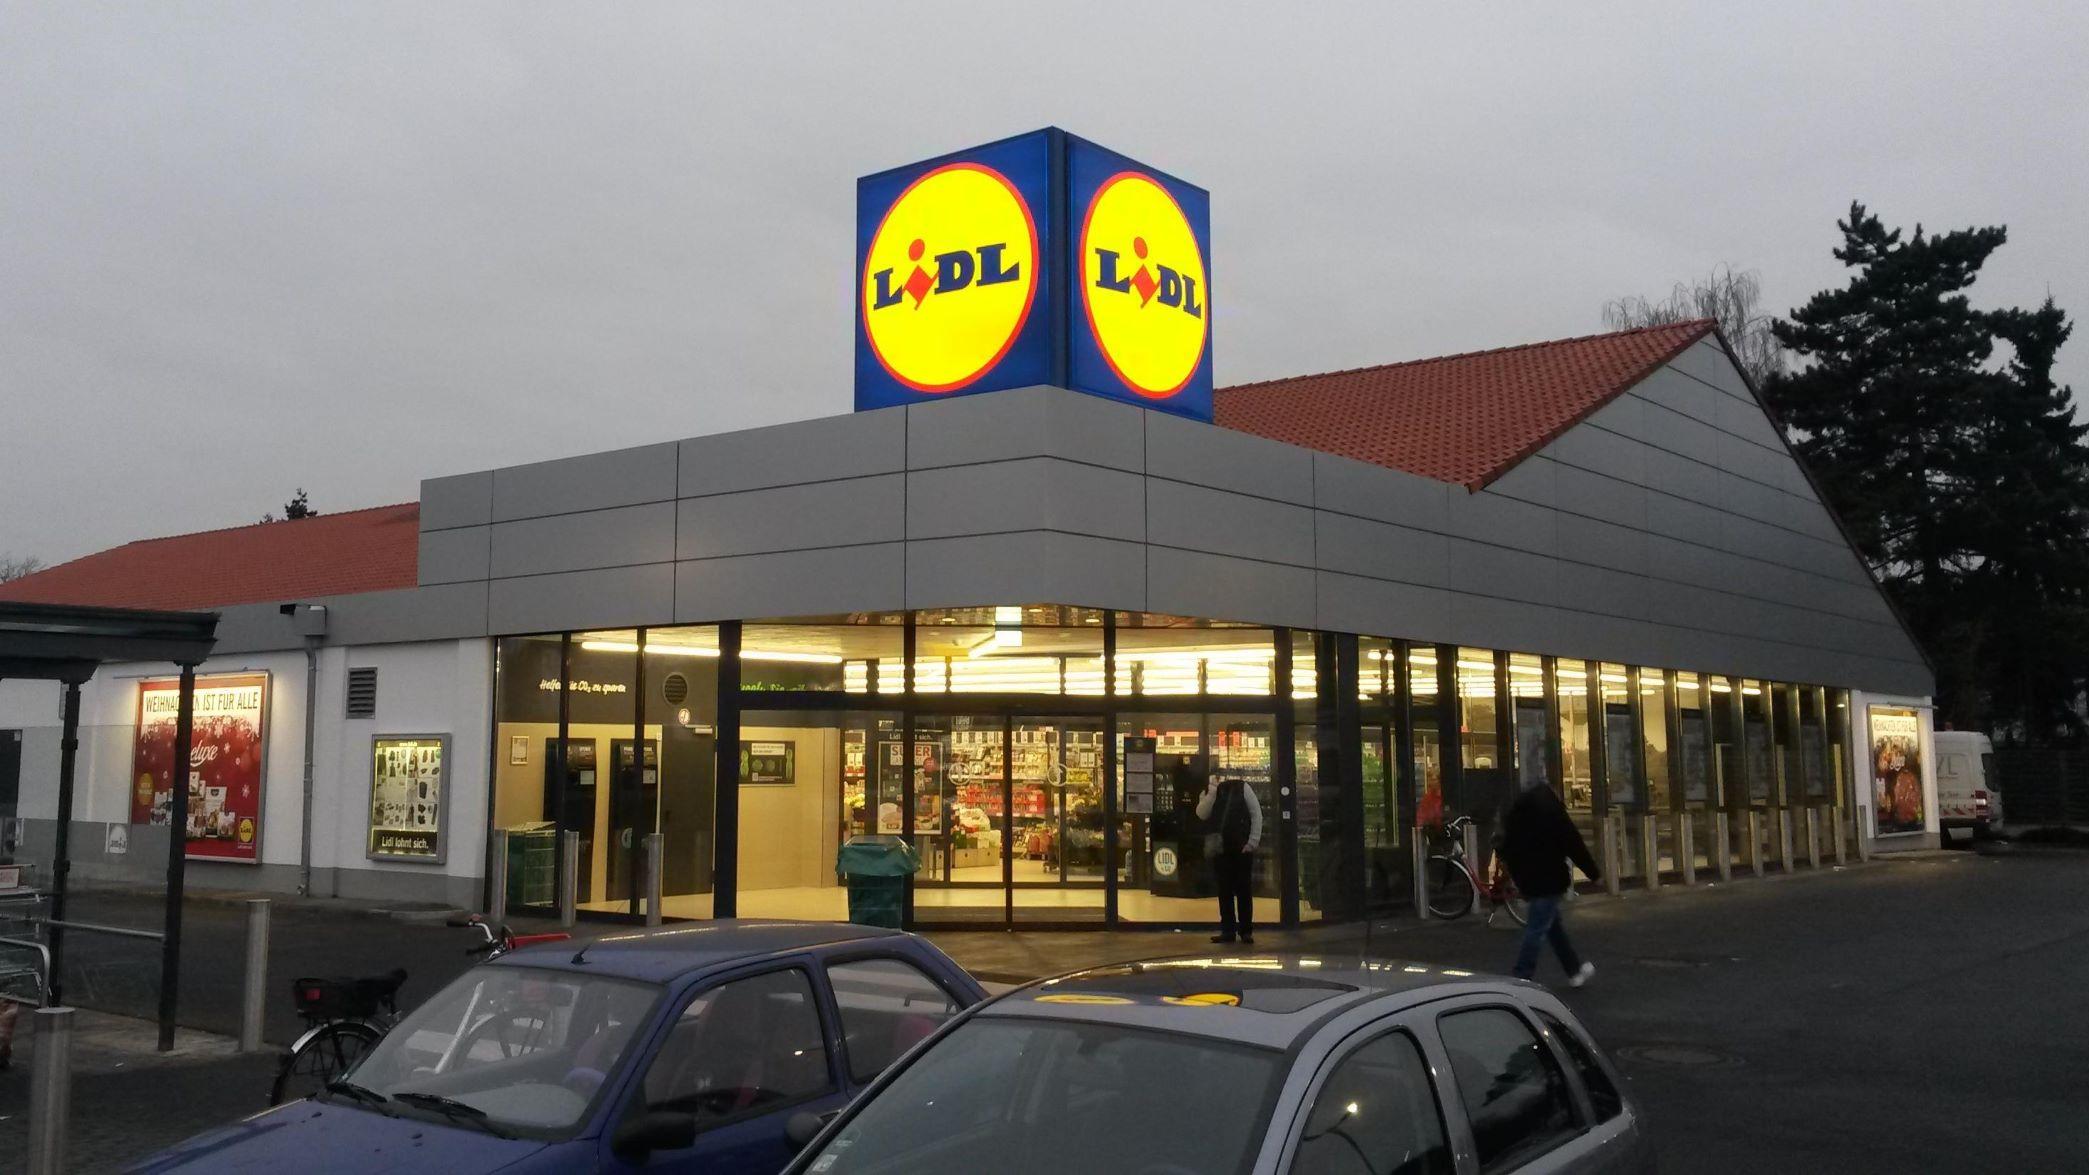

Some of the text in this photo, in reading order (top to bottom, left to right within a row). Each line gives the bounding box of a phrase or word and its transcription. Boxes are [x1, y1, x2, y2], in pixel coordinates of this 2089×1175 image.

[203, 694, 215, 710] IST
[218, 692, 234, 710] FÜR
[237, 691, 258, 709] ALLE
[382, 836, 429, 849] Lidl lohnt sich.
[1158, 852, 1174, 865] LIDL
